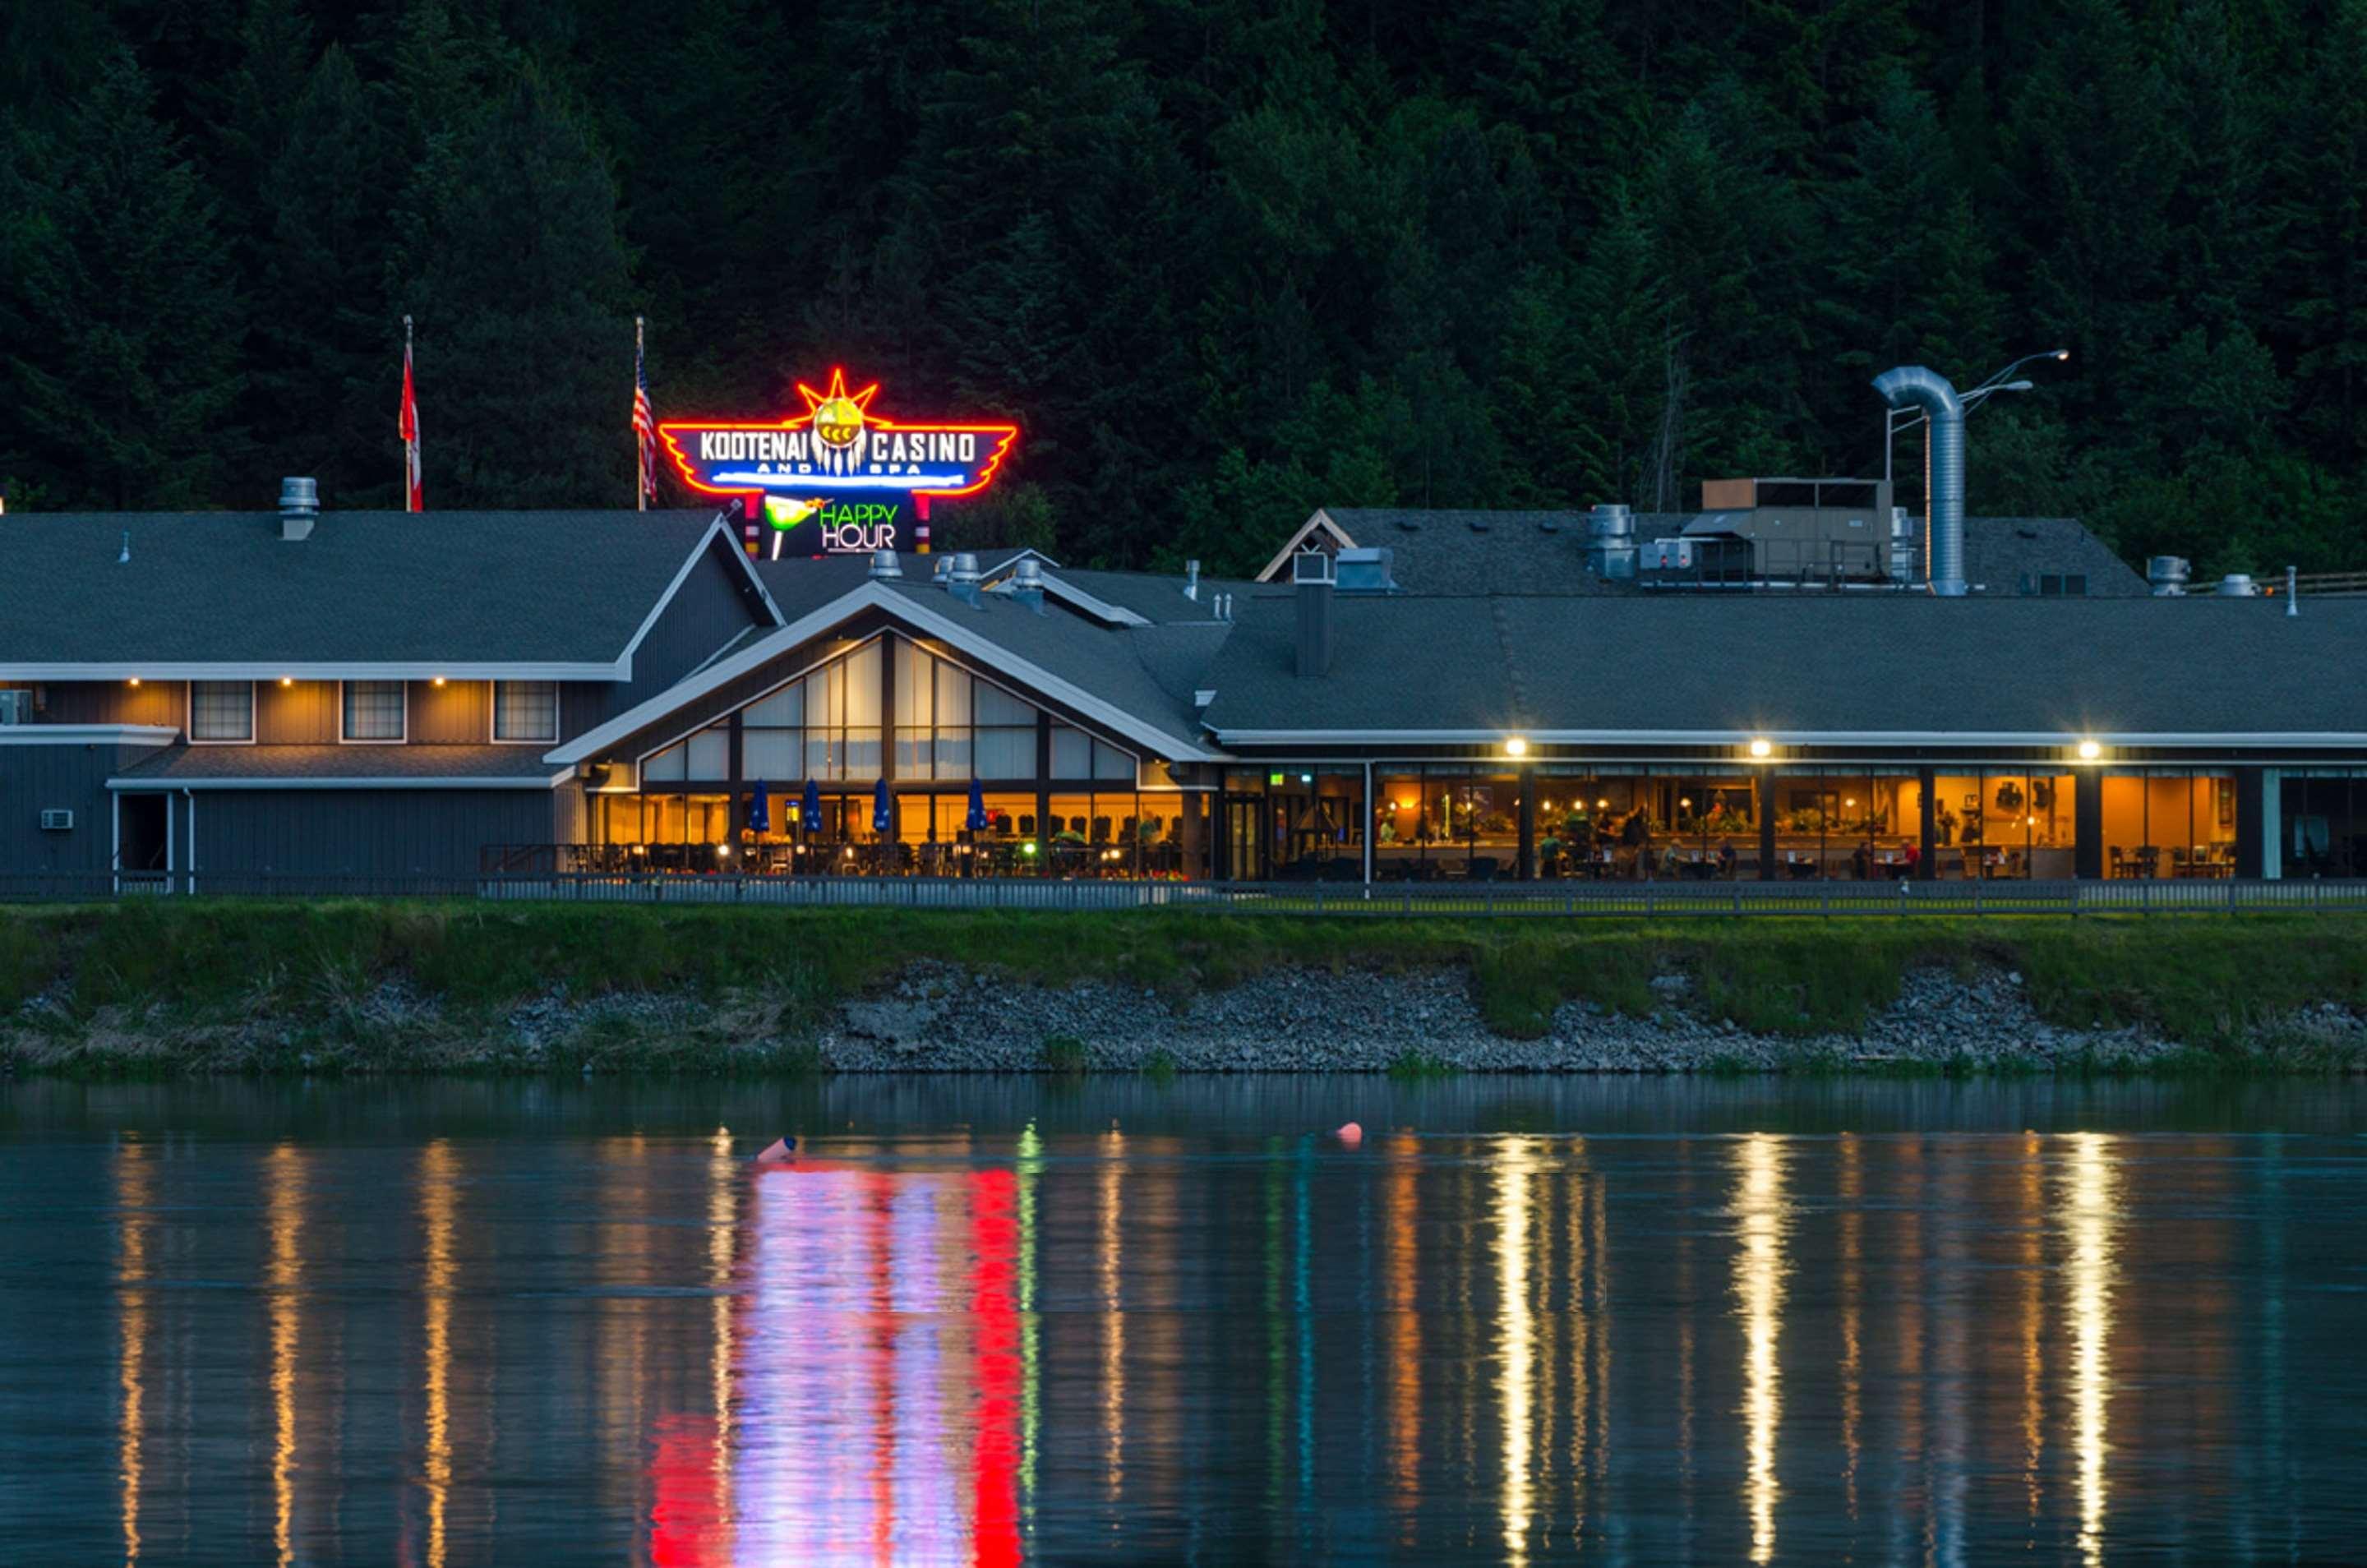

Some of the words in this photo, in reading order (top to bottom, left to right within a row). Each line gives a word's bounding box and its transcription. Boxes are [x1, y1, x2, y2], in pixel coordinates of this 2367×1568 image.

[701, 431, 807, 461] KOOTENAI
[872, 433, 976, 462] CASINO
[758, 463, 811, 473] AND
[870, 464, 920, 474] SPA
[819, 504, 898, 528] HAPPY
[822, 524, 896, 548] HOUR
